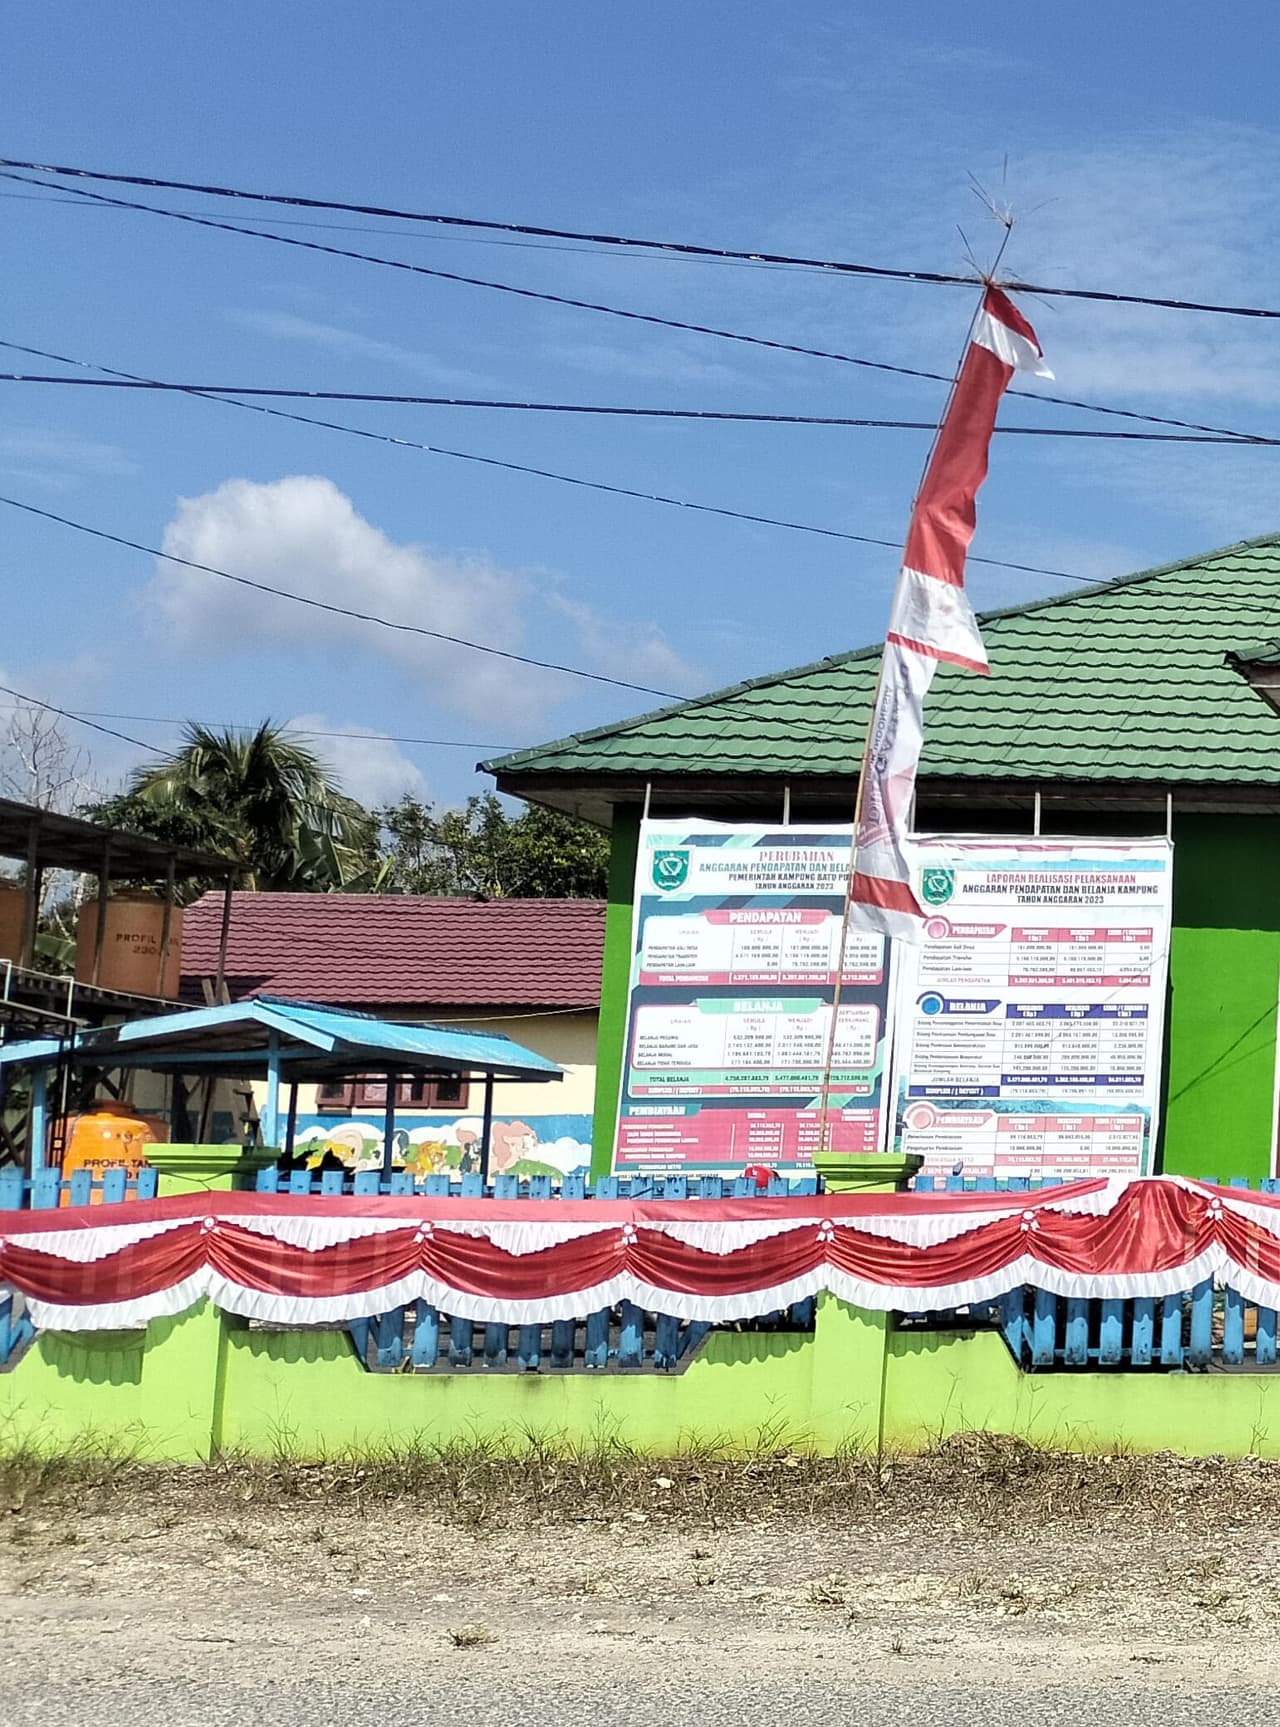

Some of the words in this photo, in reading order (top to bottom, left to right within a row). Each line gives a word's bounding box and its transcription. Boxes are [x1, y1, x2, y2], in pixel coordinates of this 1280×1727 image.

[759, 850, 835, 862] PERUBAHAN
[699, 863, 748, 872] ANGGARAN
[750, 863, 807, 872] PENDAPATAN
[809, 863, 828, 872] DAN
[829, 863, 851, 873] BELA
[728, 873, 776, 881] PEMERINTAH
[777, 873, 816, 881] KAMPUNG
[817, 873, 837, 881] BATU
[986, 873, 1026, 883] LAPORAN
[1028, 873, 1074, 884] REALISASI
[1074, 874, 1136, 884] PELAKSANAAN
[778, 882, 815, 890] ANGGARAN
[962, 884, 1008, 893] ANGGARAN
[1009, 884, 1061, 894] PENDAPATAN
[1062, 885, 1080, 894] DAN
[1081, 885, 1115, 894] BELANJA
[1117, 885, 1159, 895] KAMPUNG
[1017, 895, 1042, 904] TAHUN
[1042, 895, 1084, 904] ANGGARAN
[1085, 895, 1105, 904] 2023
[729, 911, 802, 924] PENDAPATAN
[733, 1000, 784, 1012] BELANJA
[83, 1159, 129, 1169] PROFIL
